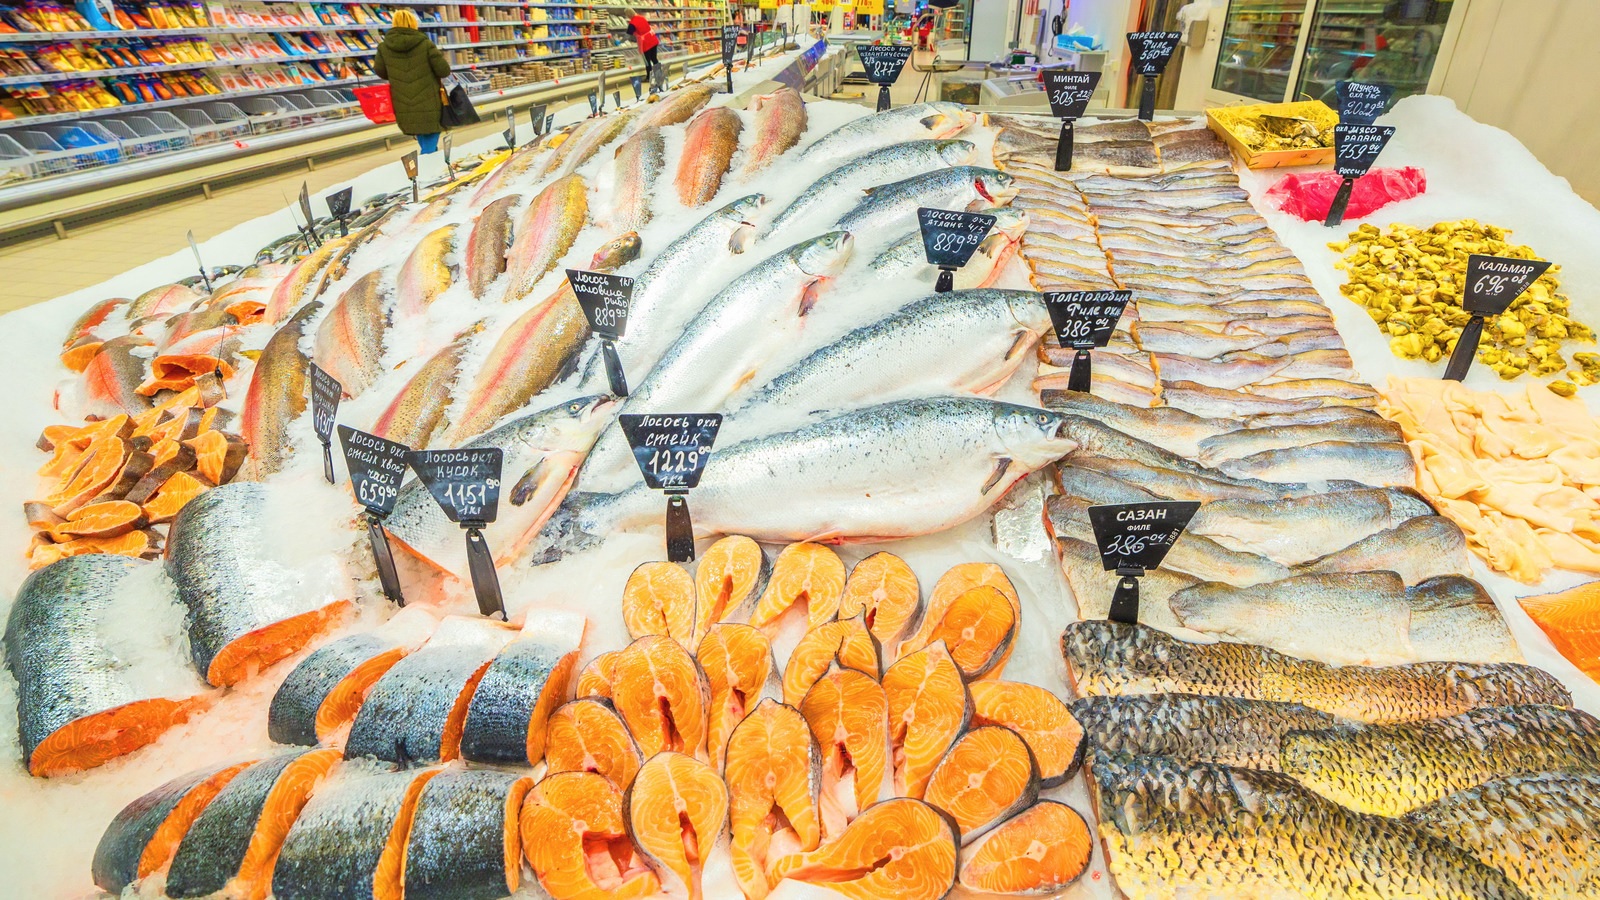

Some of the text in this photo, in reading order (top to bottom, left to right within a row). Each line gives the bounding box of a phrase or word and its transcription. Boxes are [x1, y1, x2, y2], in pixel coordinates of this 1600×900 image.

[1053, 74, 1090, 84] МИНТАЙ
[1478, 261, 1535, 275] КАЛЬМАР
[1116, 508, 1168, 522] САЗАН
